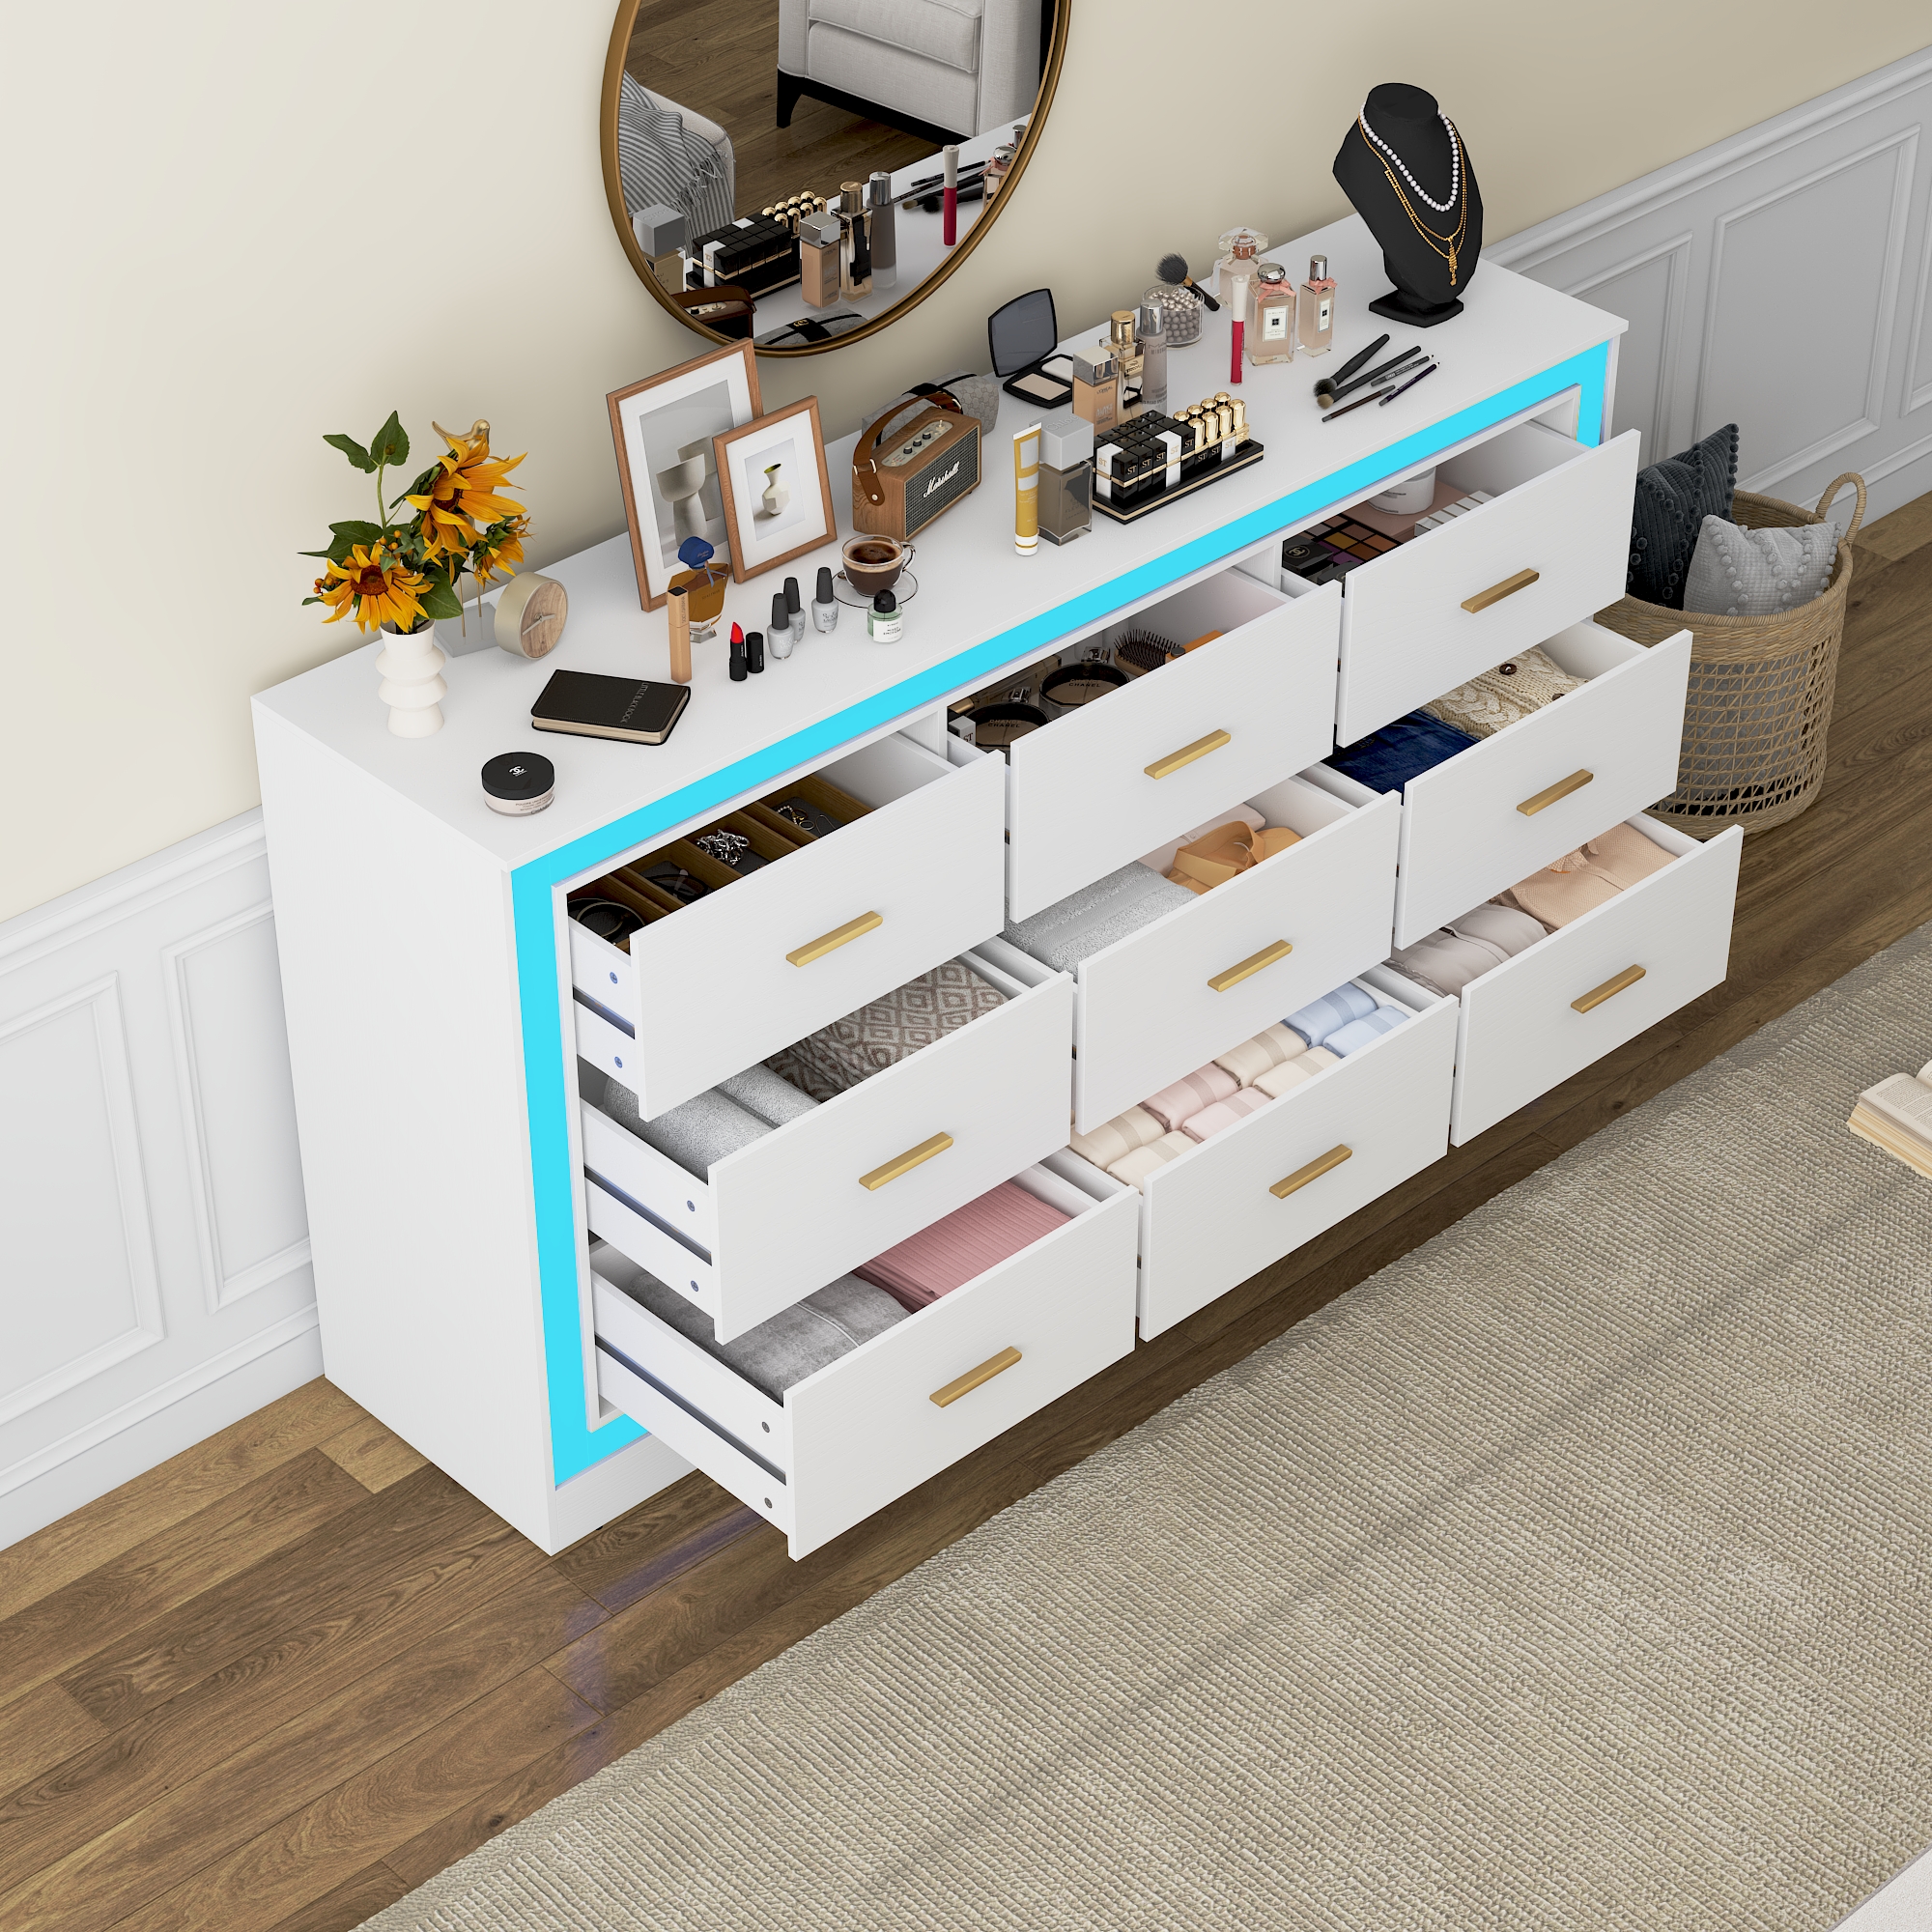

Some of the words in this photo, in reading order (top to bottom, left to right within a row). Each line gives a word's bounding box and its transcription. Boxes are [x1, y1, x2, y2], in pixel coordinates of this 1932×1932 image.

[1184, 438, 1194, 448] ST
[1225, 440, 1235, 449] ST
[1170, 444, 1179, 454] ST
[1211, 445, 1221, 456] ST
[1156, 451, 1166, 462] ST
[1198, 452, 1208, 462] ST
[1098, 457, 1107, 468] ST
[1142, 458, 1151, 469] ST
[1127, 465, 1137, 475] ST
[923, 461, 960, 498] Marshall
